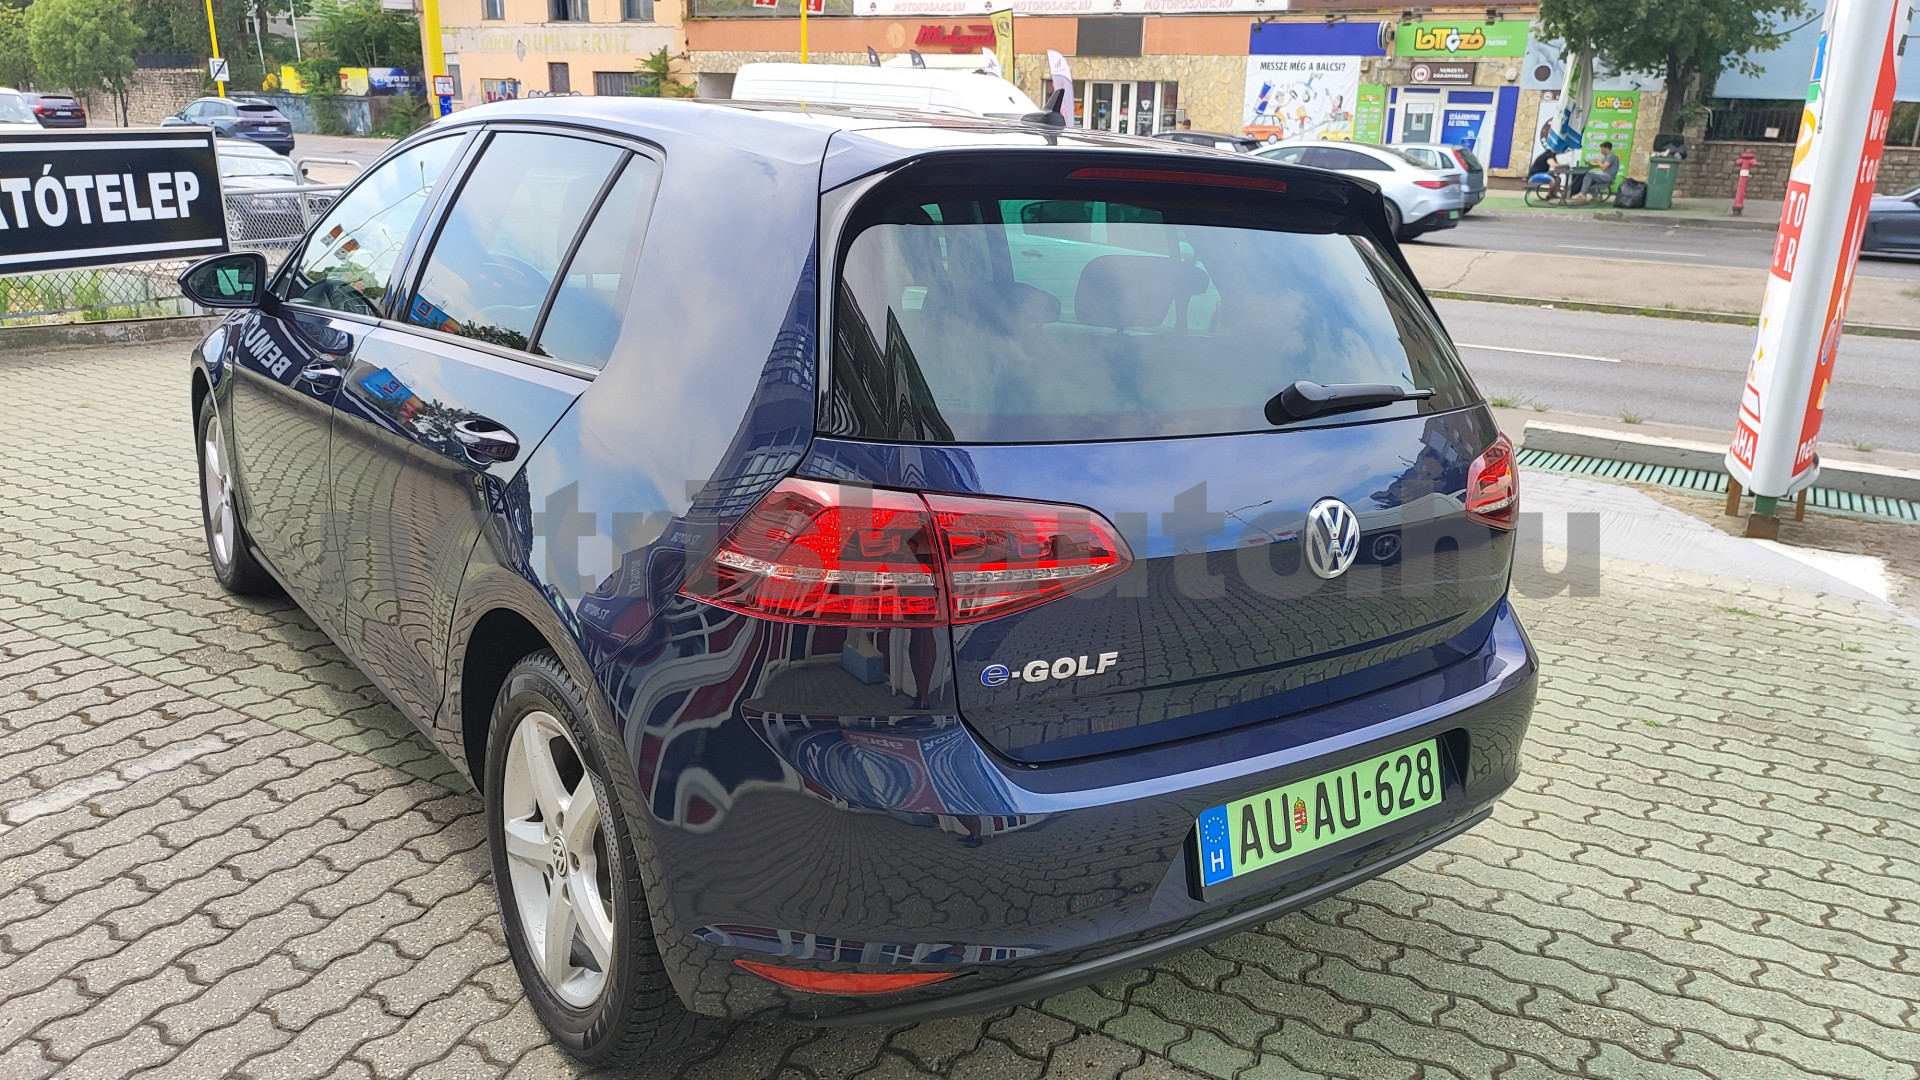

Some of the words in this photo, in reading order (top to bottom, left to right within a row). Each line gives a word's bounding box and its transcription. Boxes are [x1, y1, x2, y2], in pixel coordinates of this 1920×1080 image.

[521, 33, 630, 52] GUMISZERVIZ
[1260, 62, 1287, 71] MESSZE
[1289, 60, 1306, 71] MÉG
[1308, 62, 1314, 71] A
[1315, 62, 1346, 71] BALCSI?
[0, 164, 200, 229] TÓTELEP
[980, 651, 1119, 687] e-GOLF
[1239, 792, 1293, 866] AU
[1313, 747, 1435, 840] AU-628
[1210, 848, 1225, 873] H
